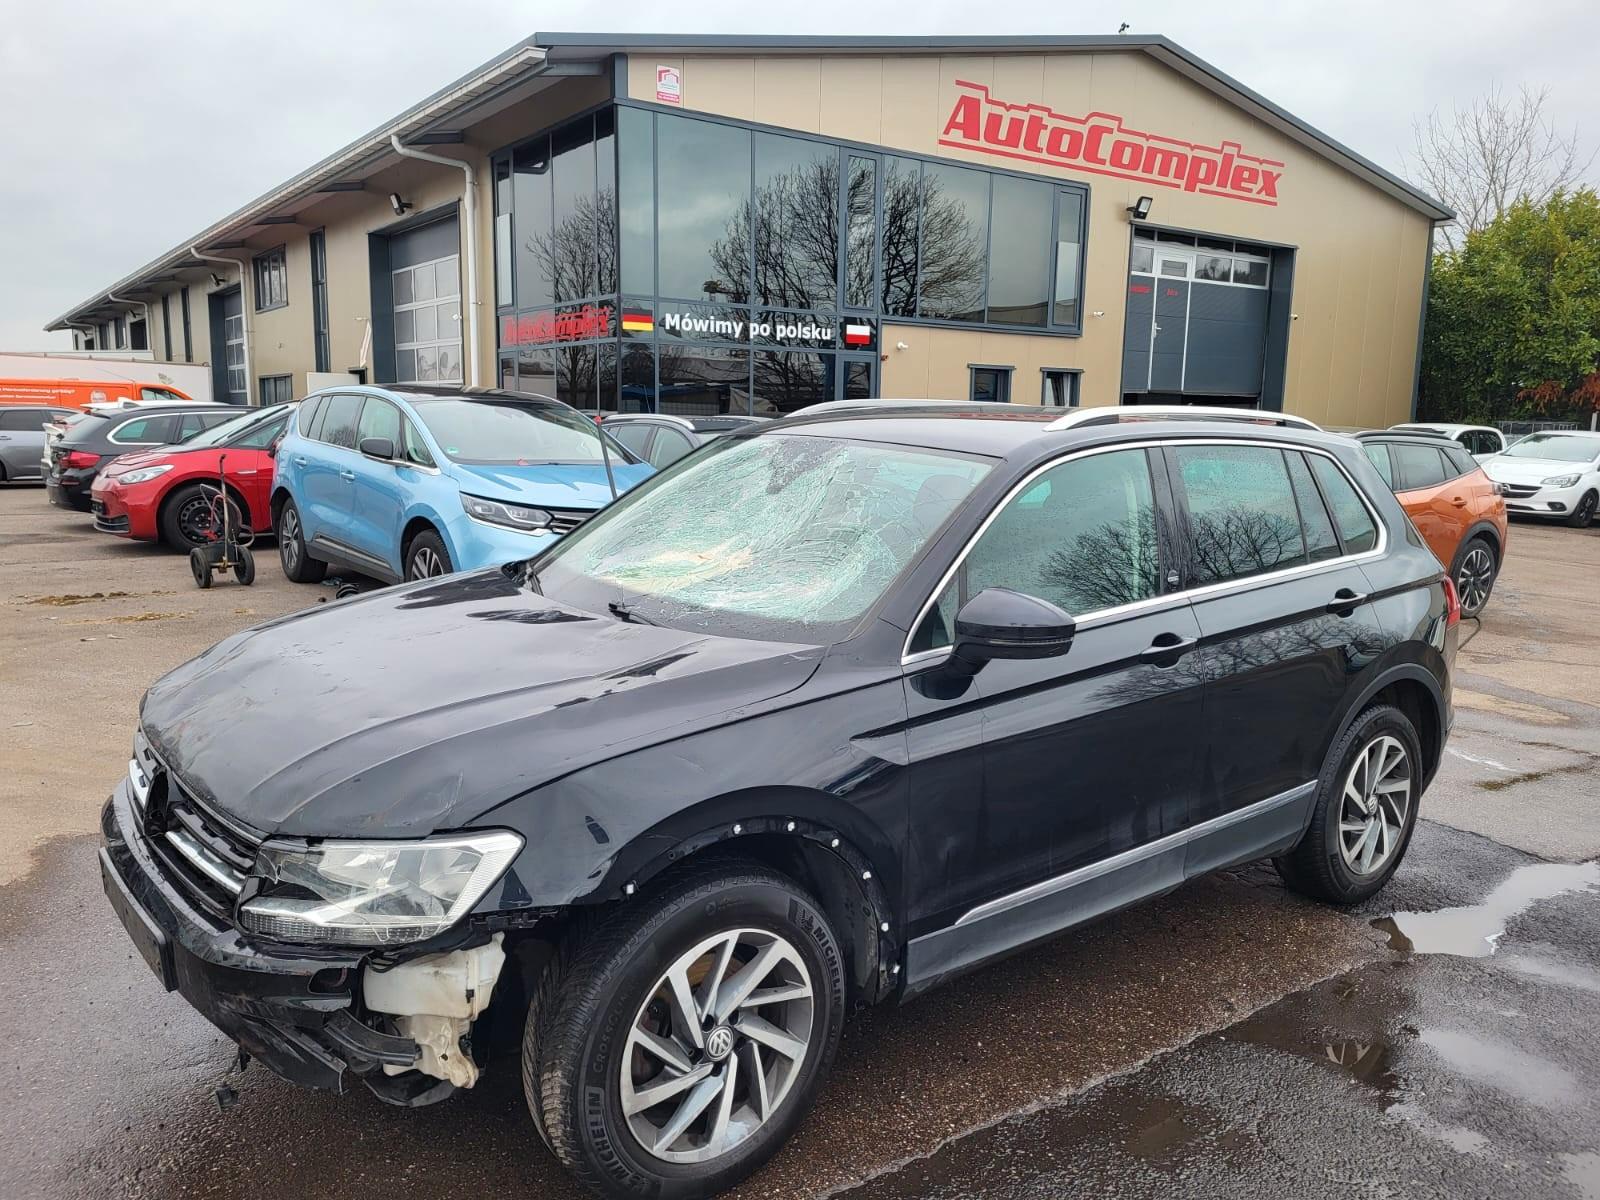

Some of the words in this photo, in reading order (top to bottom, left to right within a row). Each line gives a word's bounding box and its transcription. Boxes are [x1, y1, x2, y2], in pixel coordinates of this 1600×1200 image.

[942, 94, 1283, 198] AutoComplex
[664, 312, 743, 339] Mówimy
[749, 323, 771, 339] po
[776, 322, 831, 341] polsku
[812, 926, 842, 1007] MICHELIN
[588, 1091, 633, 1180] MICHELIN
